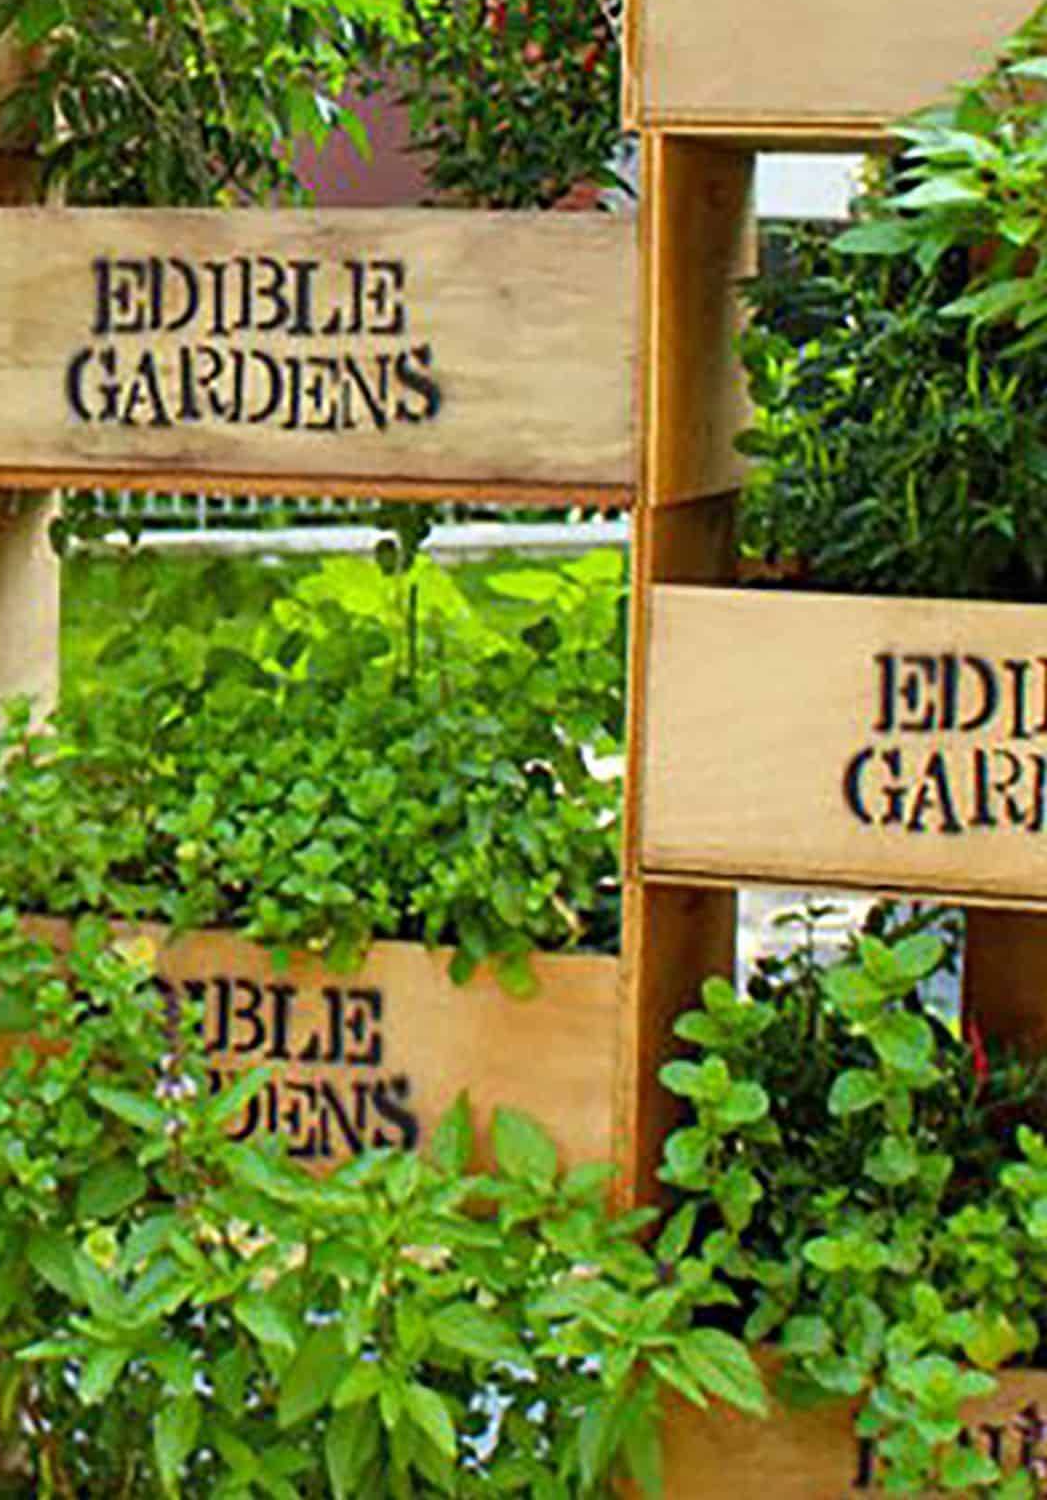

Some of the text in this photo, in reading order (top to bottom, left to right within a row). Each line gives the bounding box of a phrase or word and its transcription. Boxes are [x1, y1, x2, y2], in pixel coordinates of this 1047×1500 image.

[92, 254, 406, 336] EDIBLE
[65, 342, 442, 431] GARDENS
[873, 652, 1047, 740] EDI
